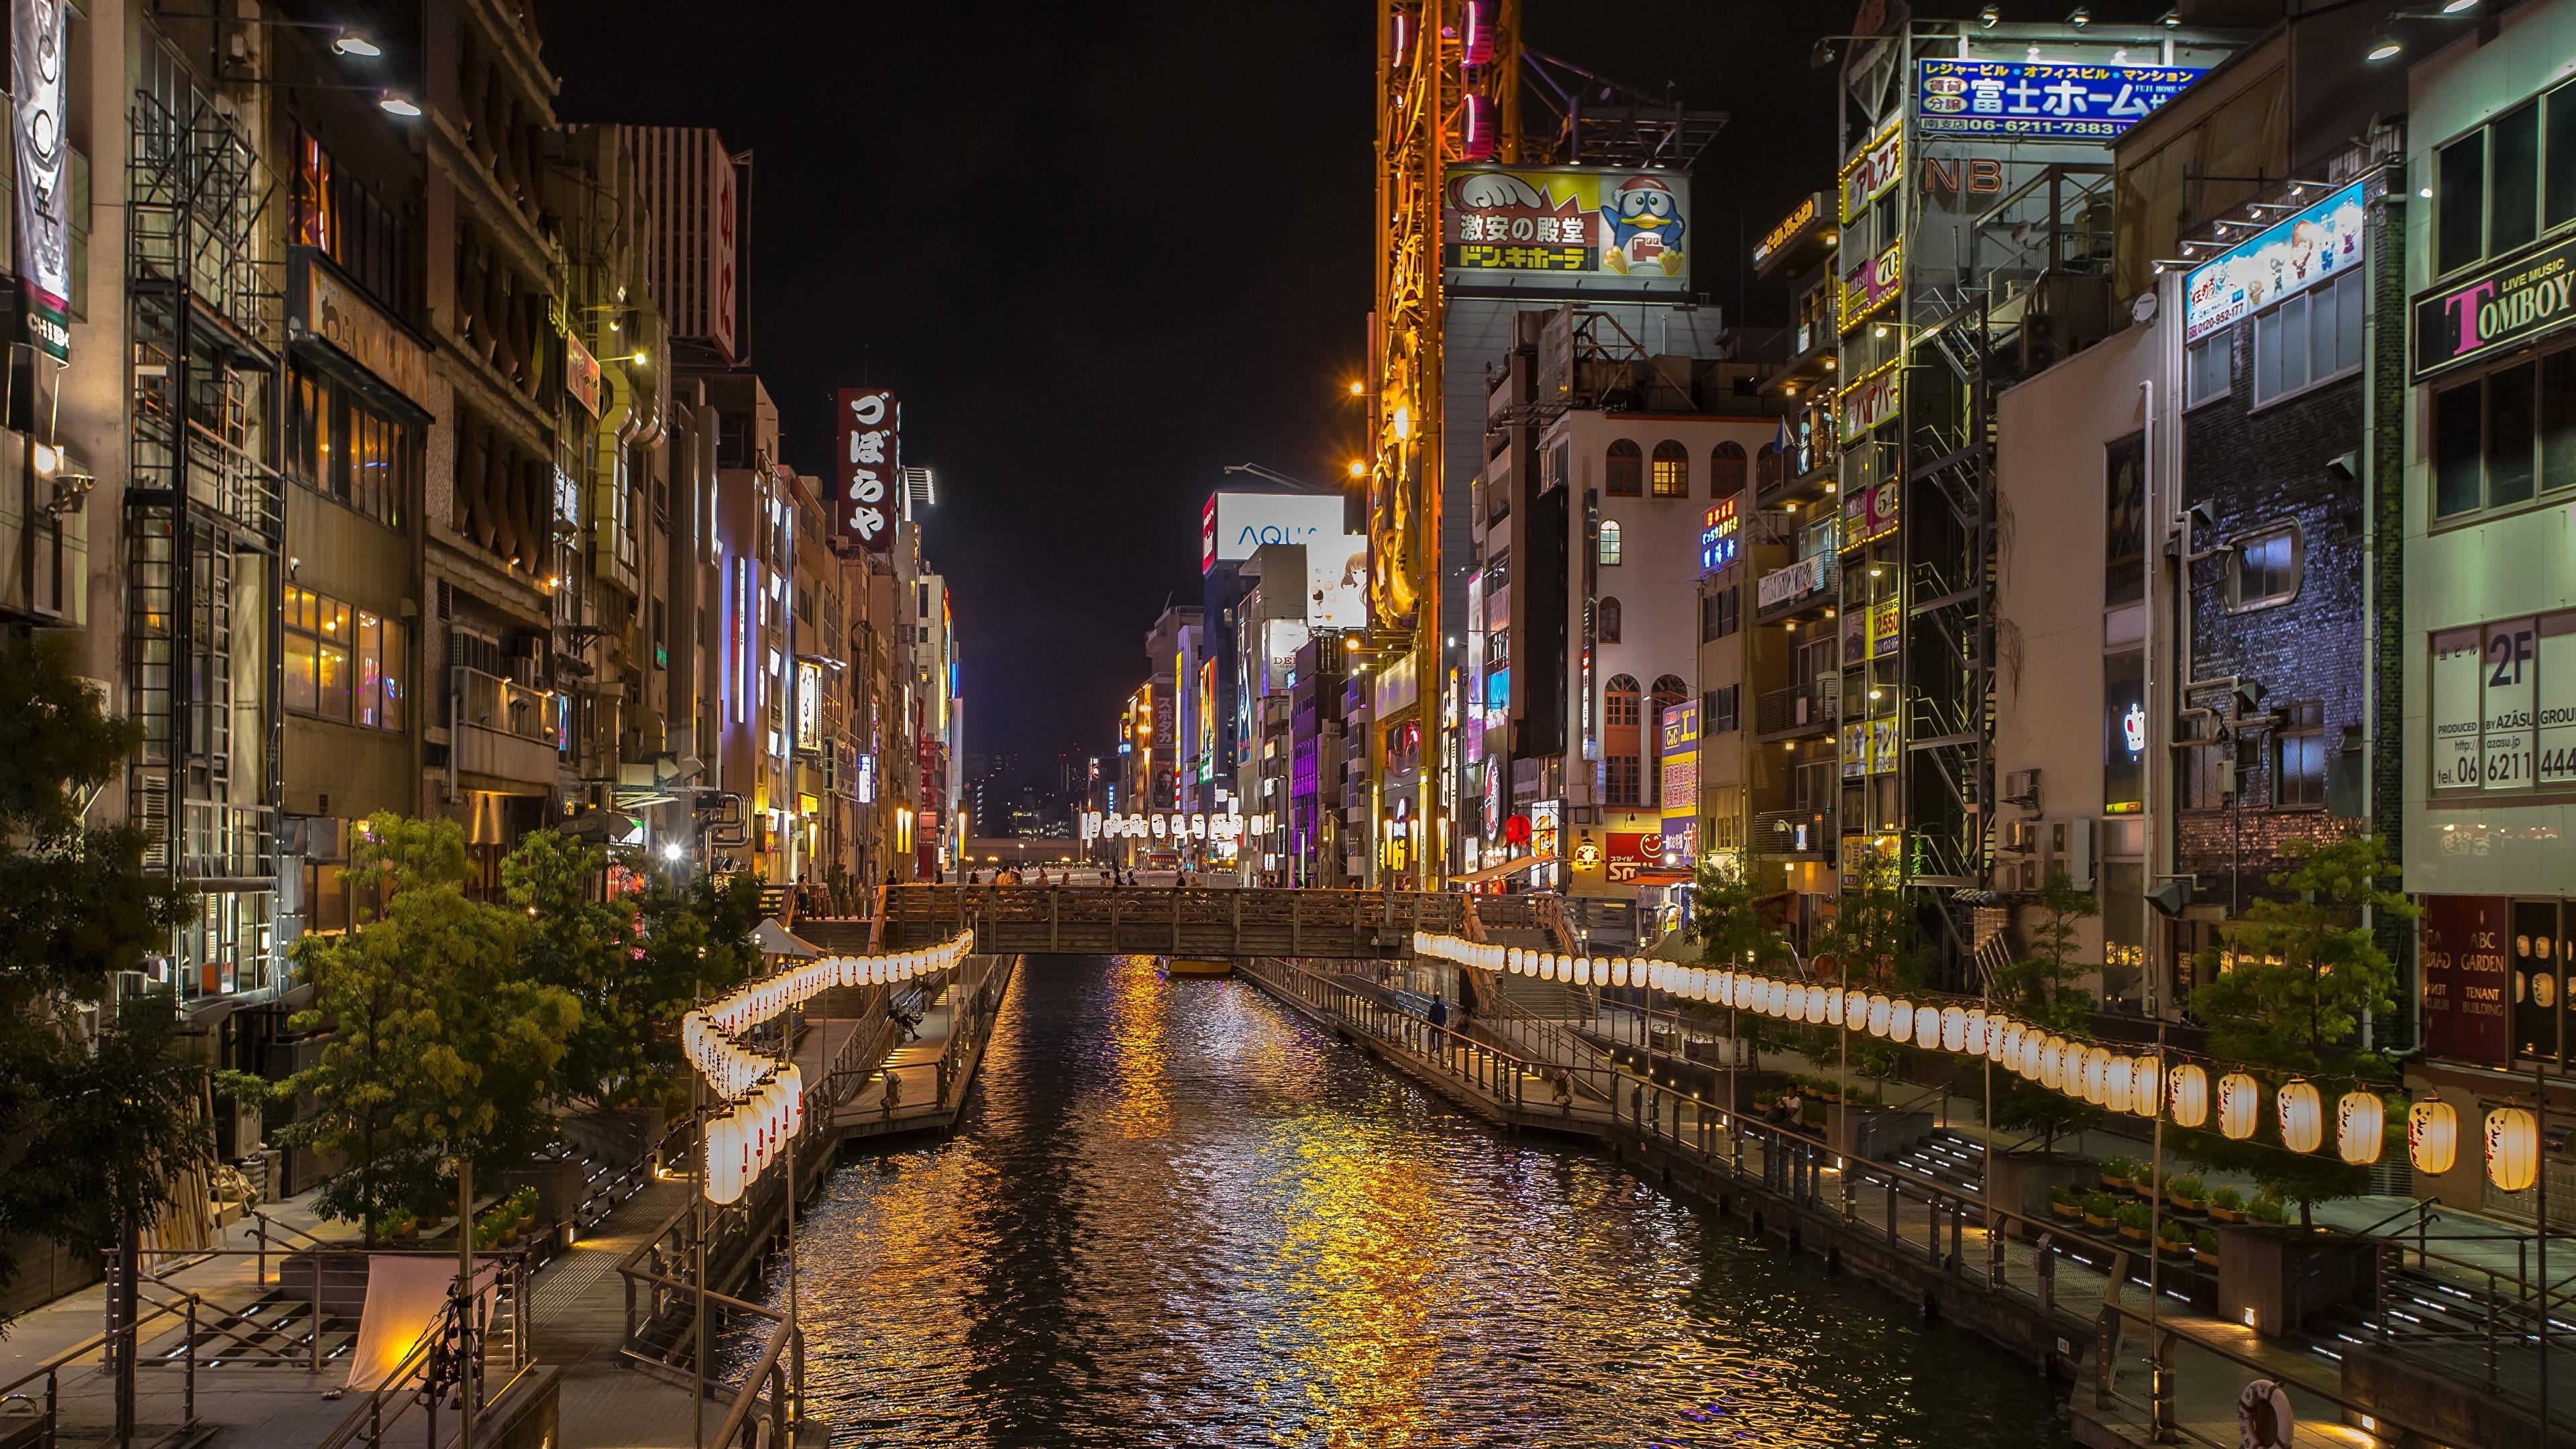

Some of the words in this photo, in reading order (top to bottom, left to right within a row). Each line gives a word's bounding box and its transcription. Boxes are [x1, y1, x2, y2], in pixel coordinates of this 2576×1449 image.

[1971, 78, 2151, 117] 富士ホーム
[2135, 85, 2153, 93] FUJI
[1969, 119, 2114, 134] 06-6211-7383
[1926, 157, 2002, 193] NB
[1460, 215, 1585, 244] 激安の殿堂
[2502, 273, 2527, 292] LIVE
[2528, 258, 2565, 282] MUSIC
[2198, 303, 2244, 333] 0120-952-177
[2445, 270, 2575, 356] TOMBOY
[850, 392, 891, 541] づぼらや
[1238, 525, 1318, 545] AQU
[2489, 631, 2532, 688] 2F
[1159, 698, 1172, 743] スポタカ
[2438, 722, 2477, 735] PRODUCED
[2486, 720, 2496, 730] BY
[2540, 707, 2576, 724] GROU
[1666, 730, 1678, 747] C&C
[2487, 736, 2520, 751] azasu.jp
[2438, 769, 2454, 784] tel.
[2458, 757, 2477, 784] 06
[2487, 752, 2530, 782] 6211
[2470, 932, 2496, 949] ABC
[2461, 954, 2504, 973] GARDEN
[2465, 987, 2500, 1001] TENANT
[2462, 1002, 2503, 1016] BUILDING
